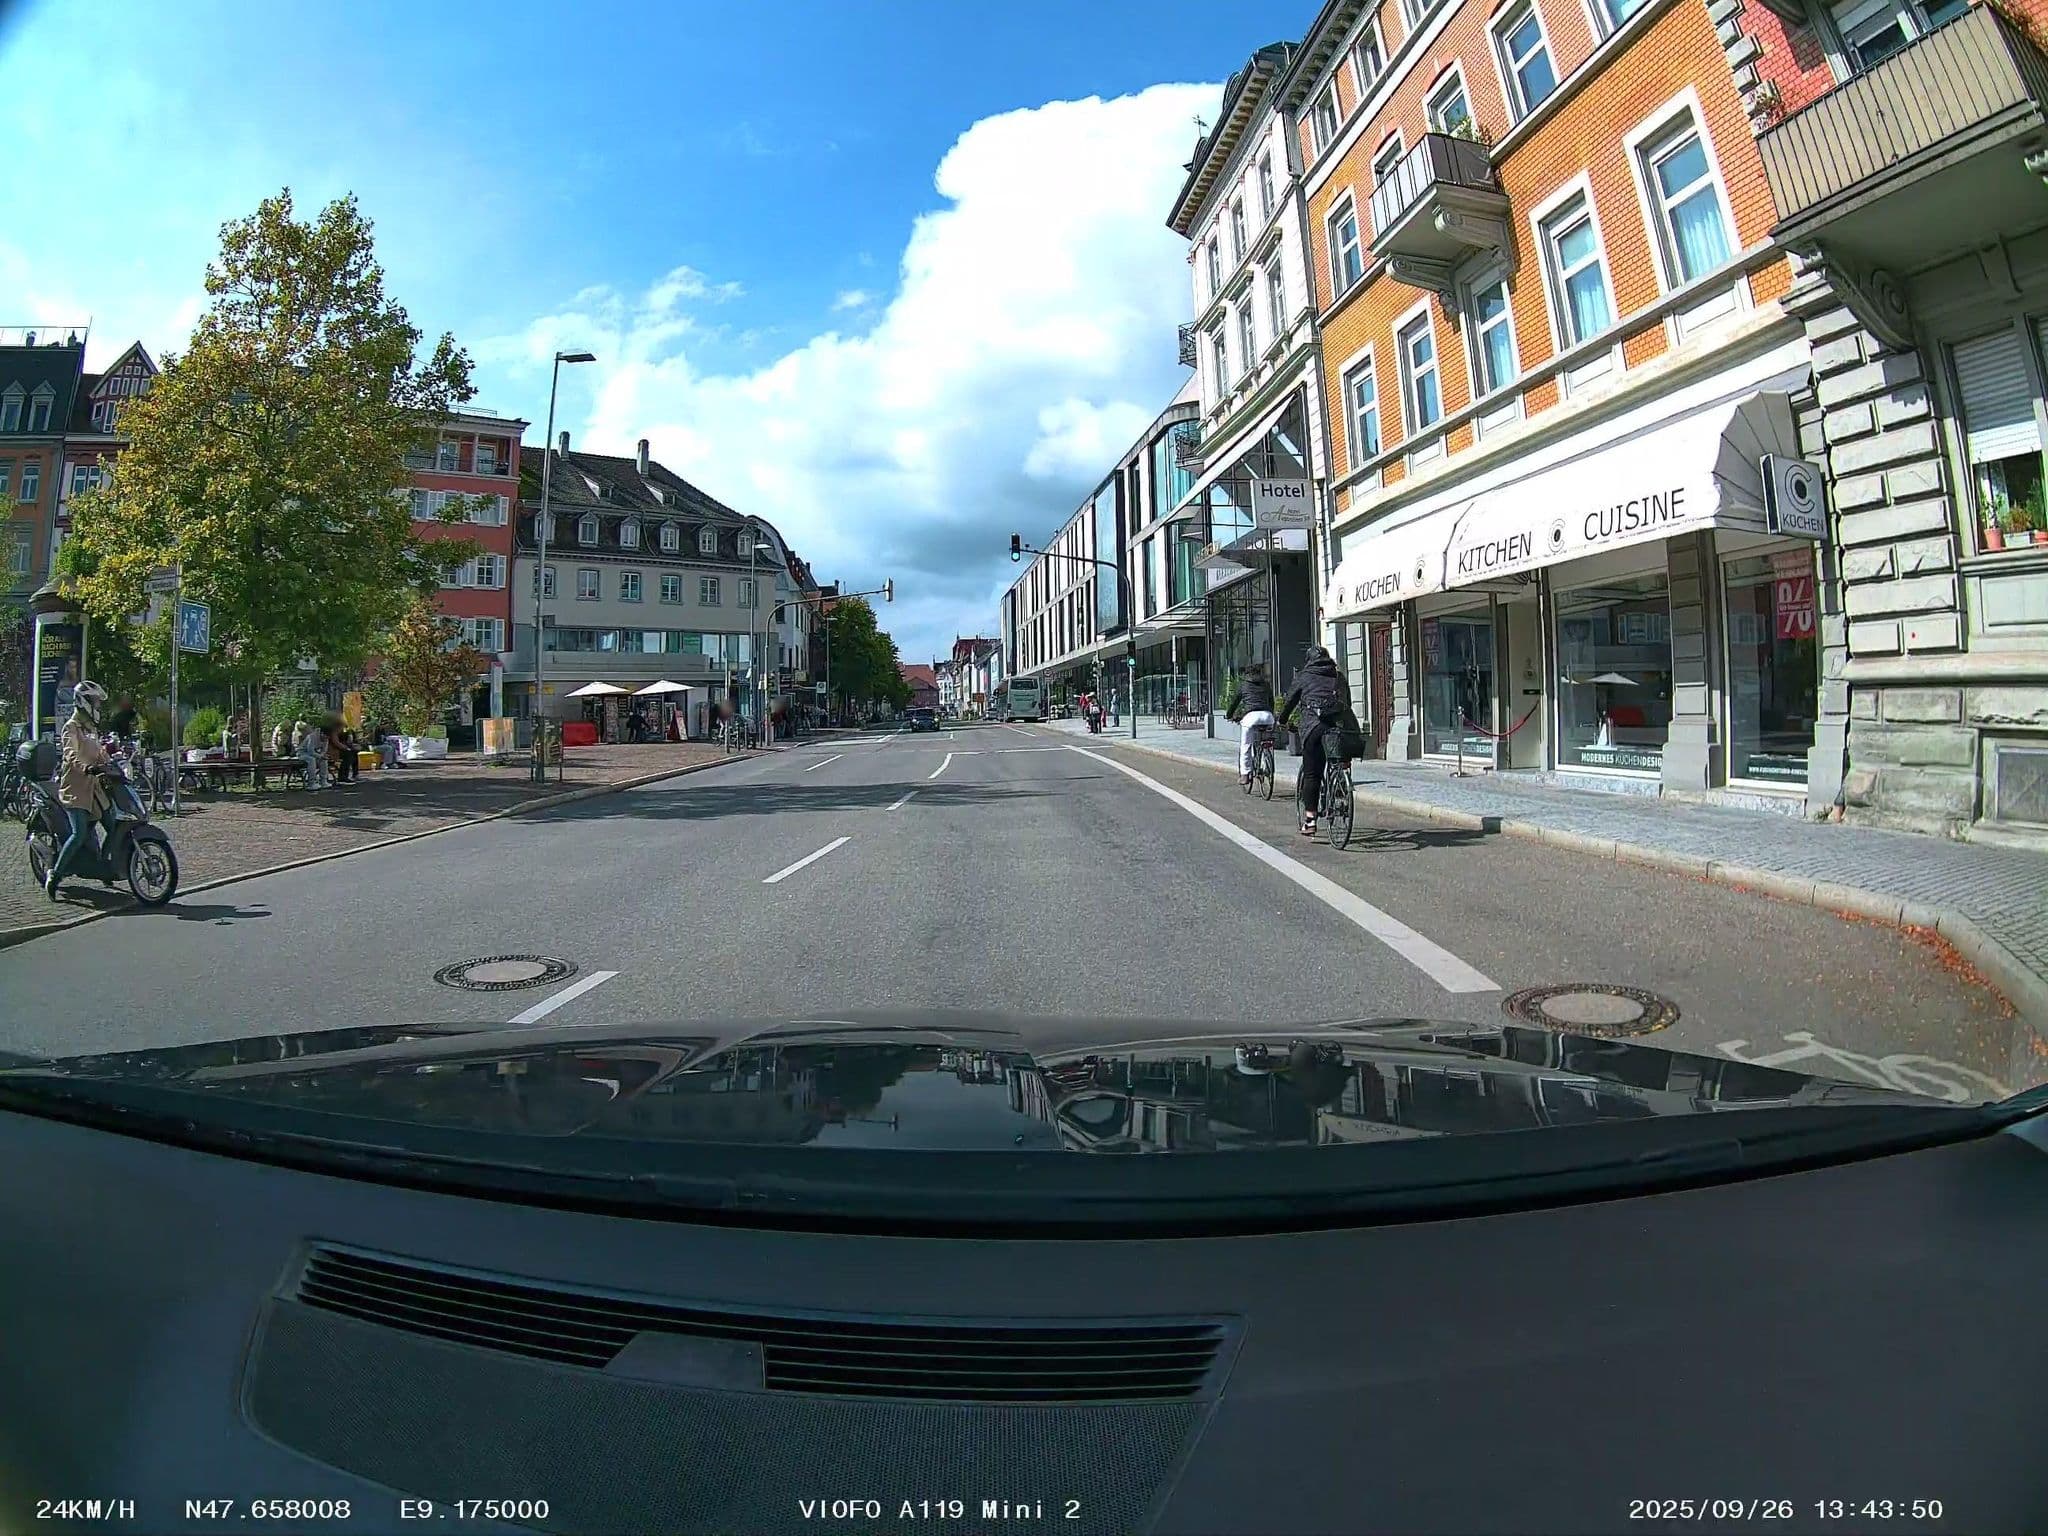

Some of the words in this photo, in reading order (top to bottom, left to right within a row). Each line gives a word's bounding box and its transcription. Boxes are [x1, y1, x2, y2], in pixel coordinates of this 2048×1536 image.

[1261, 483, 1306, 498] Hotel
[1584, 488, 1685, 541] CUISINE
[1458, 531, 1532, 574] KITCHEN
[1581, 752, 1614, 764] MODERNES
[1614, 754, 1663, 767] KÜCHENDESIG
